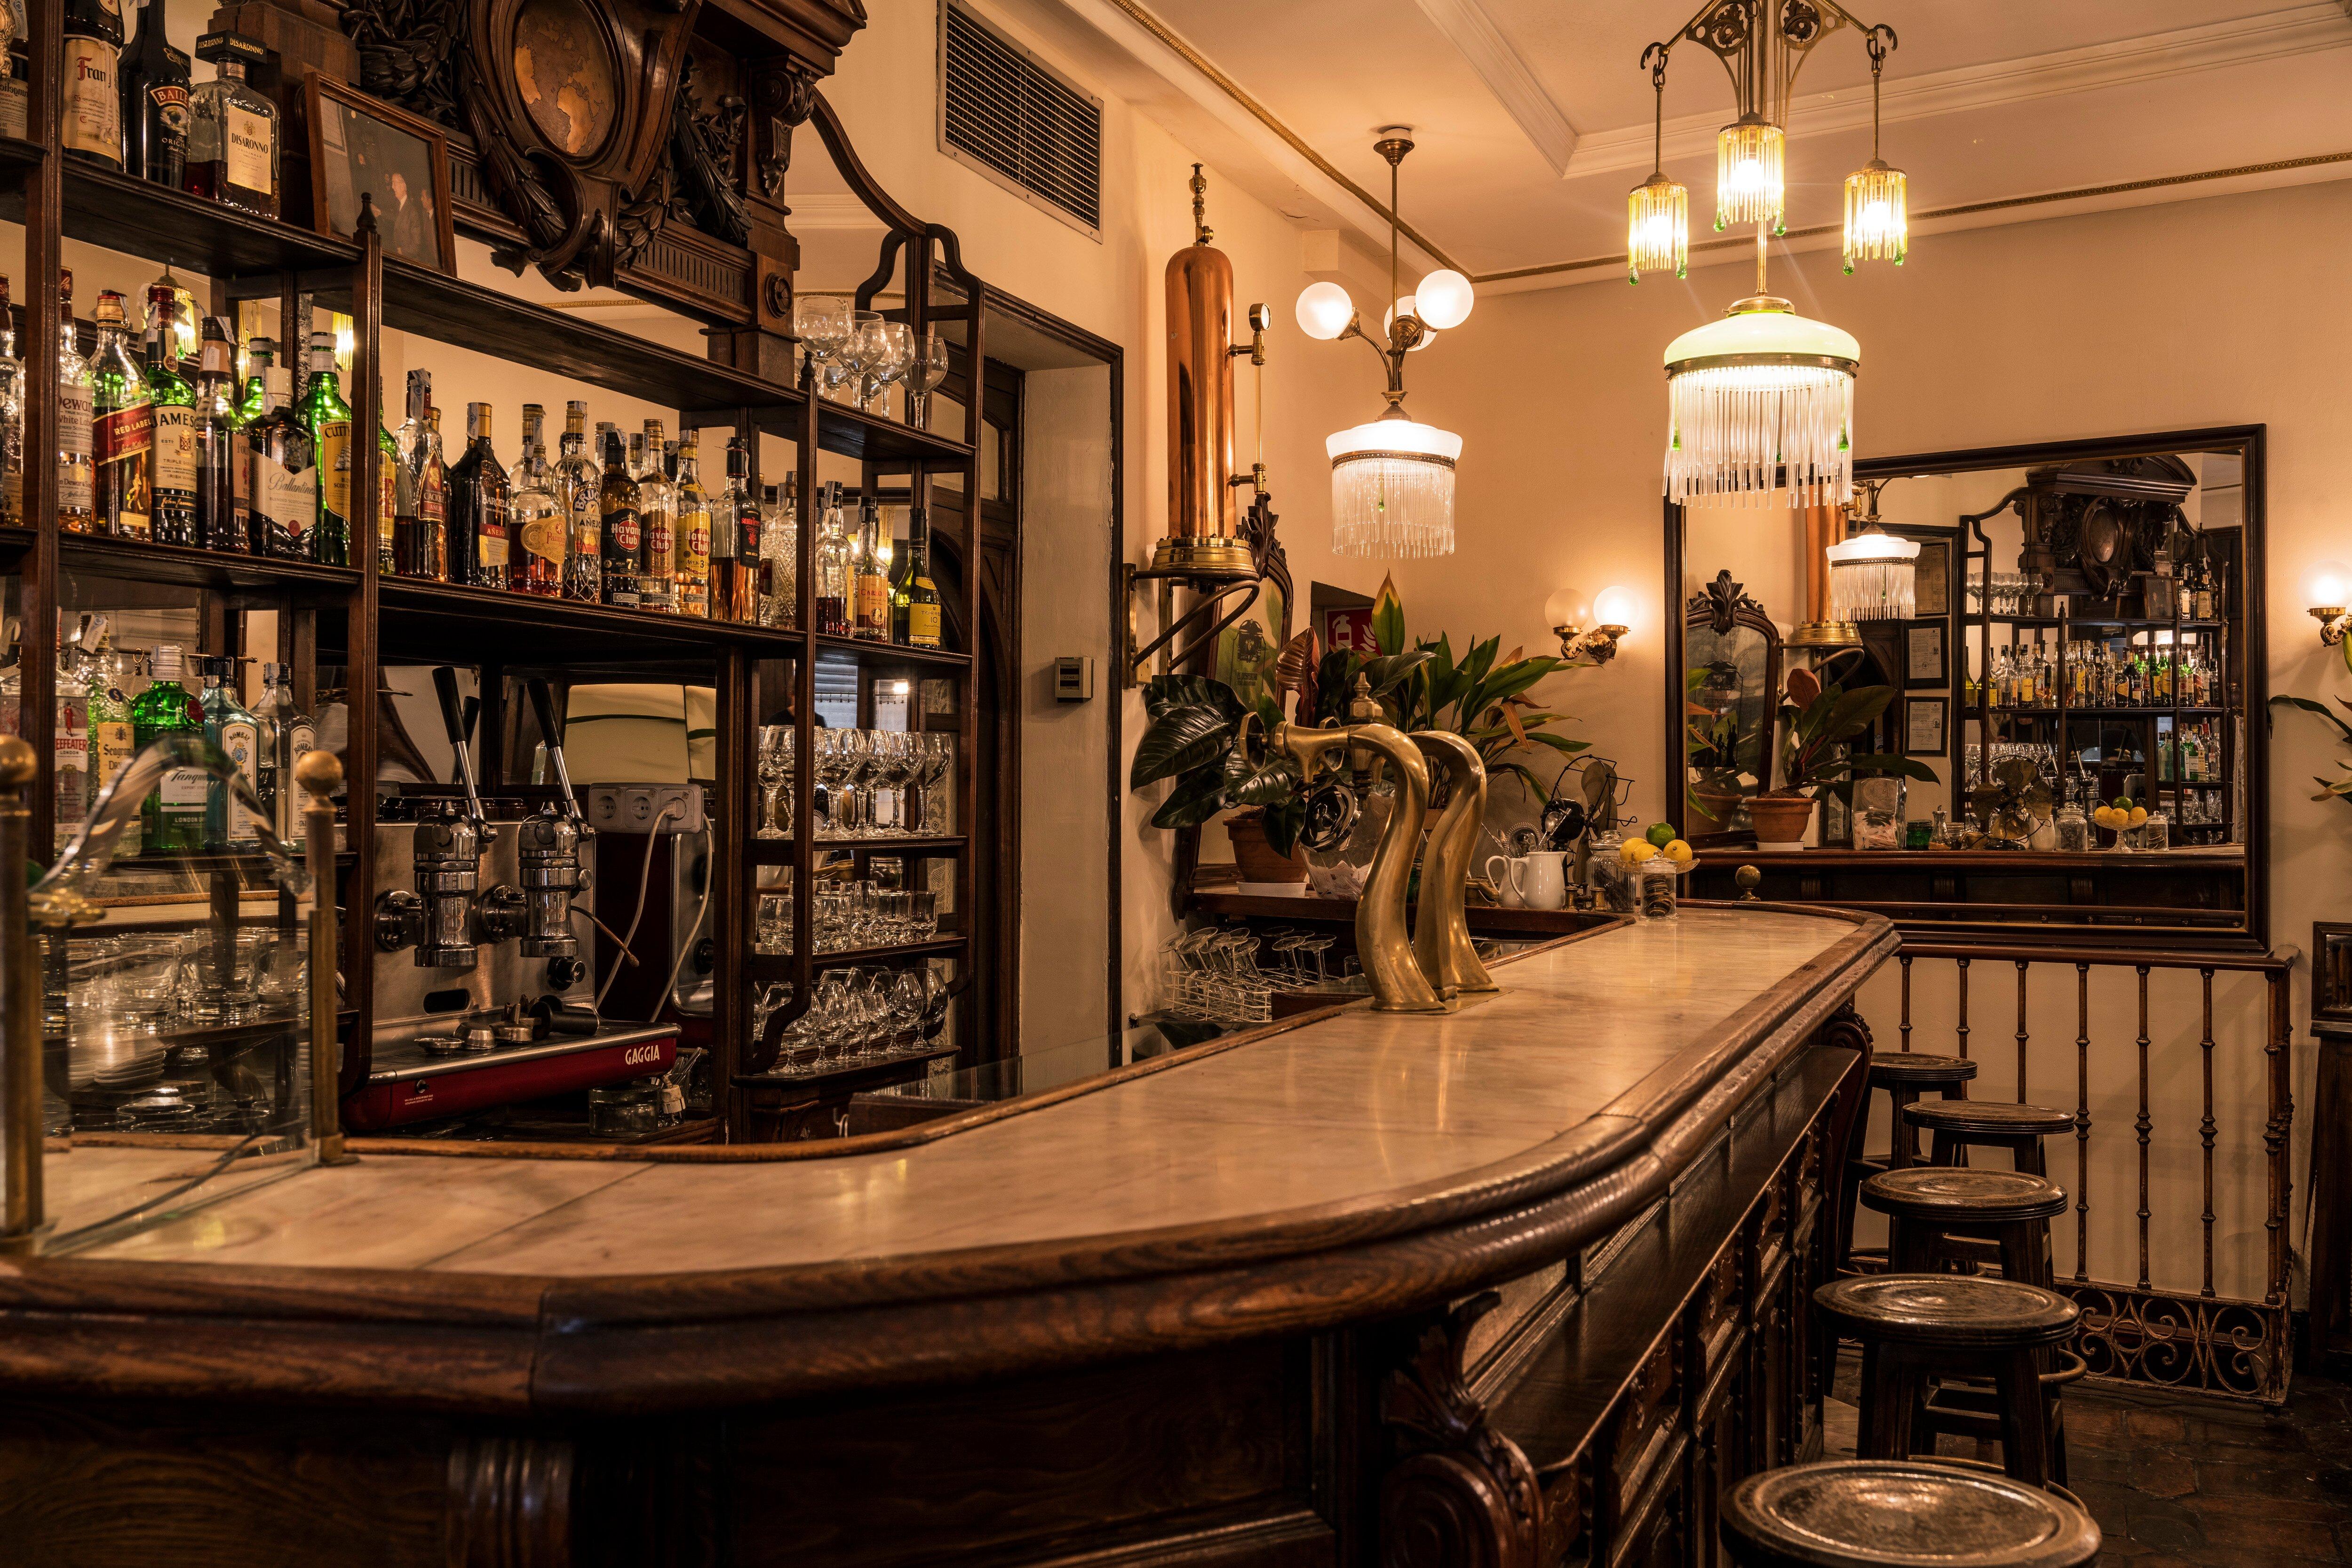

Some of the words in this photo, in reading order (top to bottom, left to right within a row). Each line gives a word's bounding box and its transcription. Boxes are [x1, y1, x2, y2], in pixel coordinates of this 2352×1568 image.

[198, 37, 223, 49] DISARONNO
[230, 38, 263, 55] DISARONNO
[157, 89, 188, 101] BAILE
[231, 133, 268, 153] DISARONNO
[238, 148, 262, 159] ORIGINALE
[114, 425, 130, 435] RED
[131, 418, 151, 430] LABEL
[487, 527, 505, 537] AÑEJO
[644, 530, 674, 541] Havana
[620, 533, 637, 545] Club
[651, 540, 669, 549] Club
[692, 541, 708, 552] Club
[626, 558, 633, 570] 7
[700, 560, 704, 568] 3
[56, 738, 87, 752] EEFEATER
[625, 1045, 660, 1065] GAGGIA
